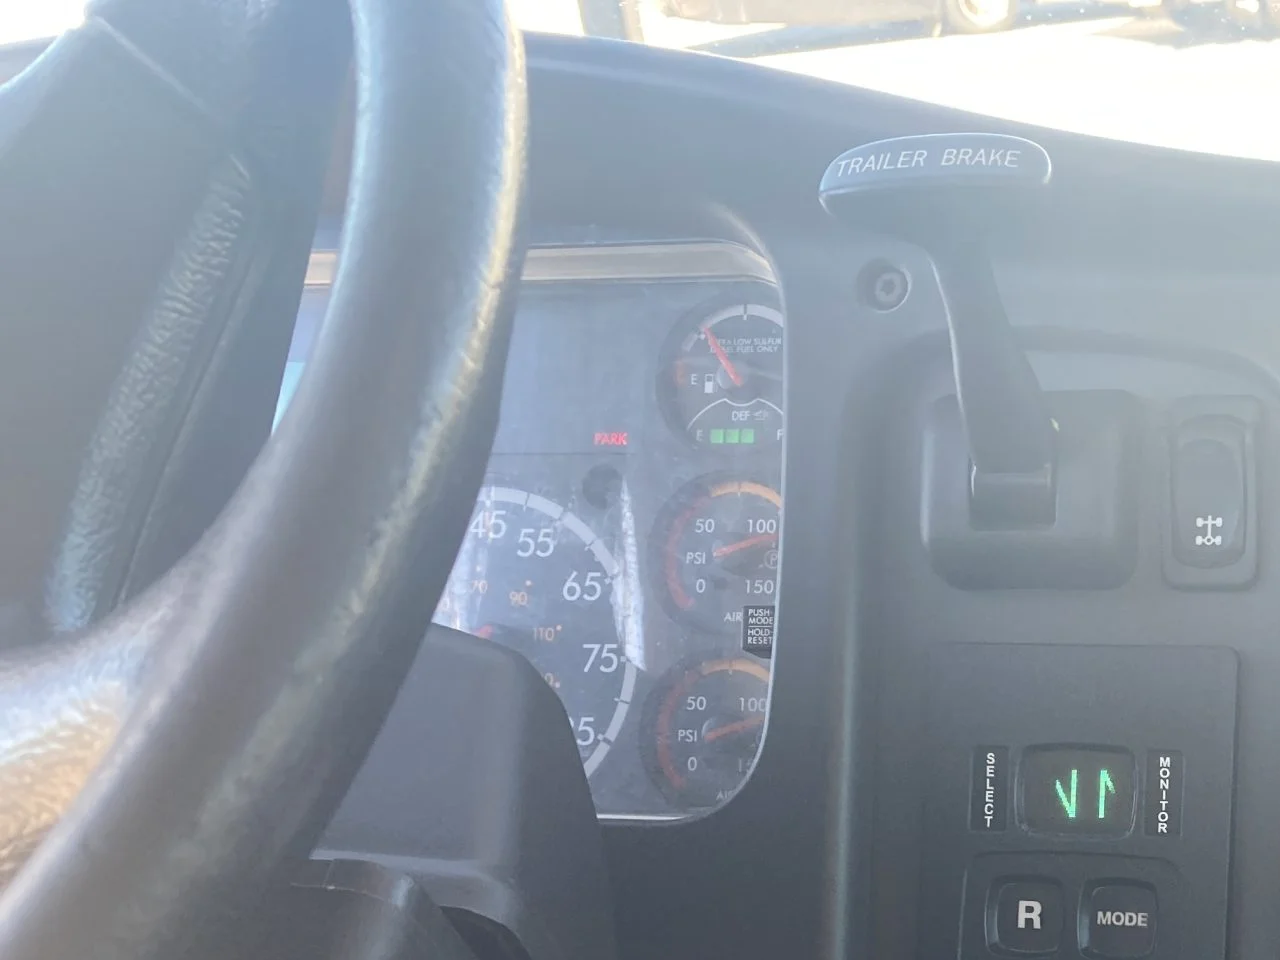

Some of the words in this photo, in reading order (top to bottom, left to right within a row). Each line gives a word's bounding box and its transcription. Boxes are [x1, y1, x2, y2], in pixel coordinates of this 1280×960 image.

[836, 149, 929, 178] TRAILER
[940, 147, 1022, 169] BRAKE
[733, 338, 752, 346] LOW
[736, 345, 754, 353] FUEL
[756, 345, 779, 353] ONLY
[731, 411, 750, 421] DEF
[593, 432, 628, 446] PARK
[470, 510, 508, 539] 45
[695, 519, 715, 533] 50
[747, 519, 777, 534] 100
[516, 528, 555, 557] 55
[686, 552, 706, 564] PSI
[562, 571, 602, 601] 65
[696, 579, 706, 594] 0
[745, 579, 774, 594] 150
[724, 611, 743, 622] AIR
[748, 616, 774, 625] MODE
[747, 636, 773, 645] RESET
[582, 643, 618, 673] 75
[686, 696, 707, 711] 50
[678, 729, 698, 742] PSI
[687, 756, 698, 772] 0
[984, 752, 995, 829] SELECT
[1157, 756, 1172, 835] MONITOR
[1016, 900, 1043, 930] R
[1096, 909, 1148, 928] MODE
